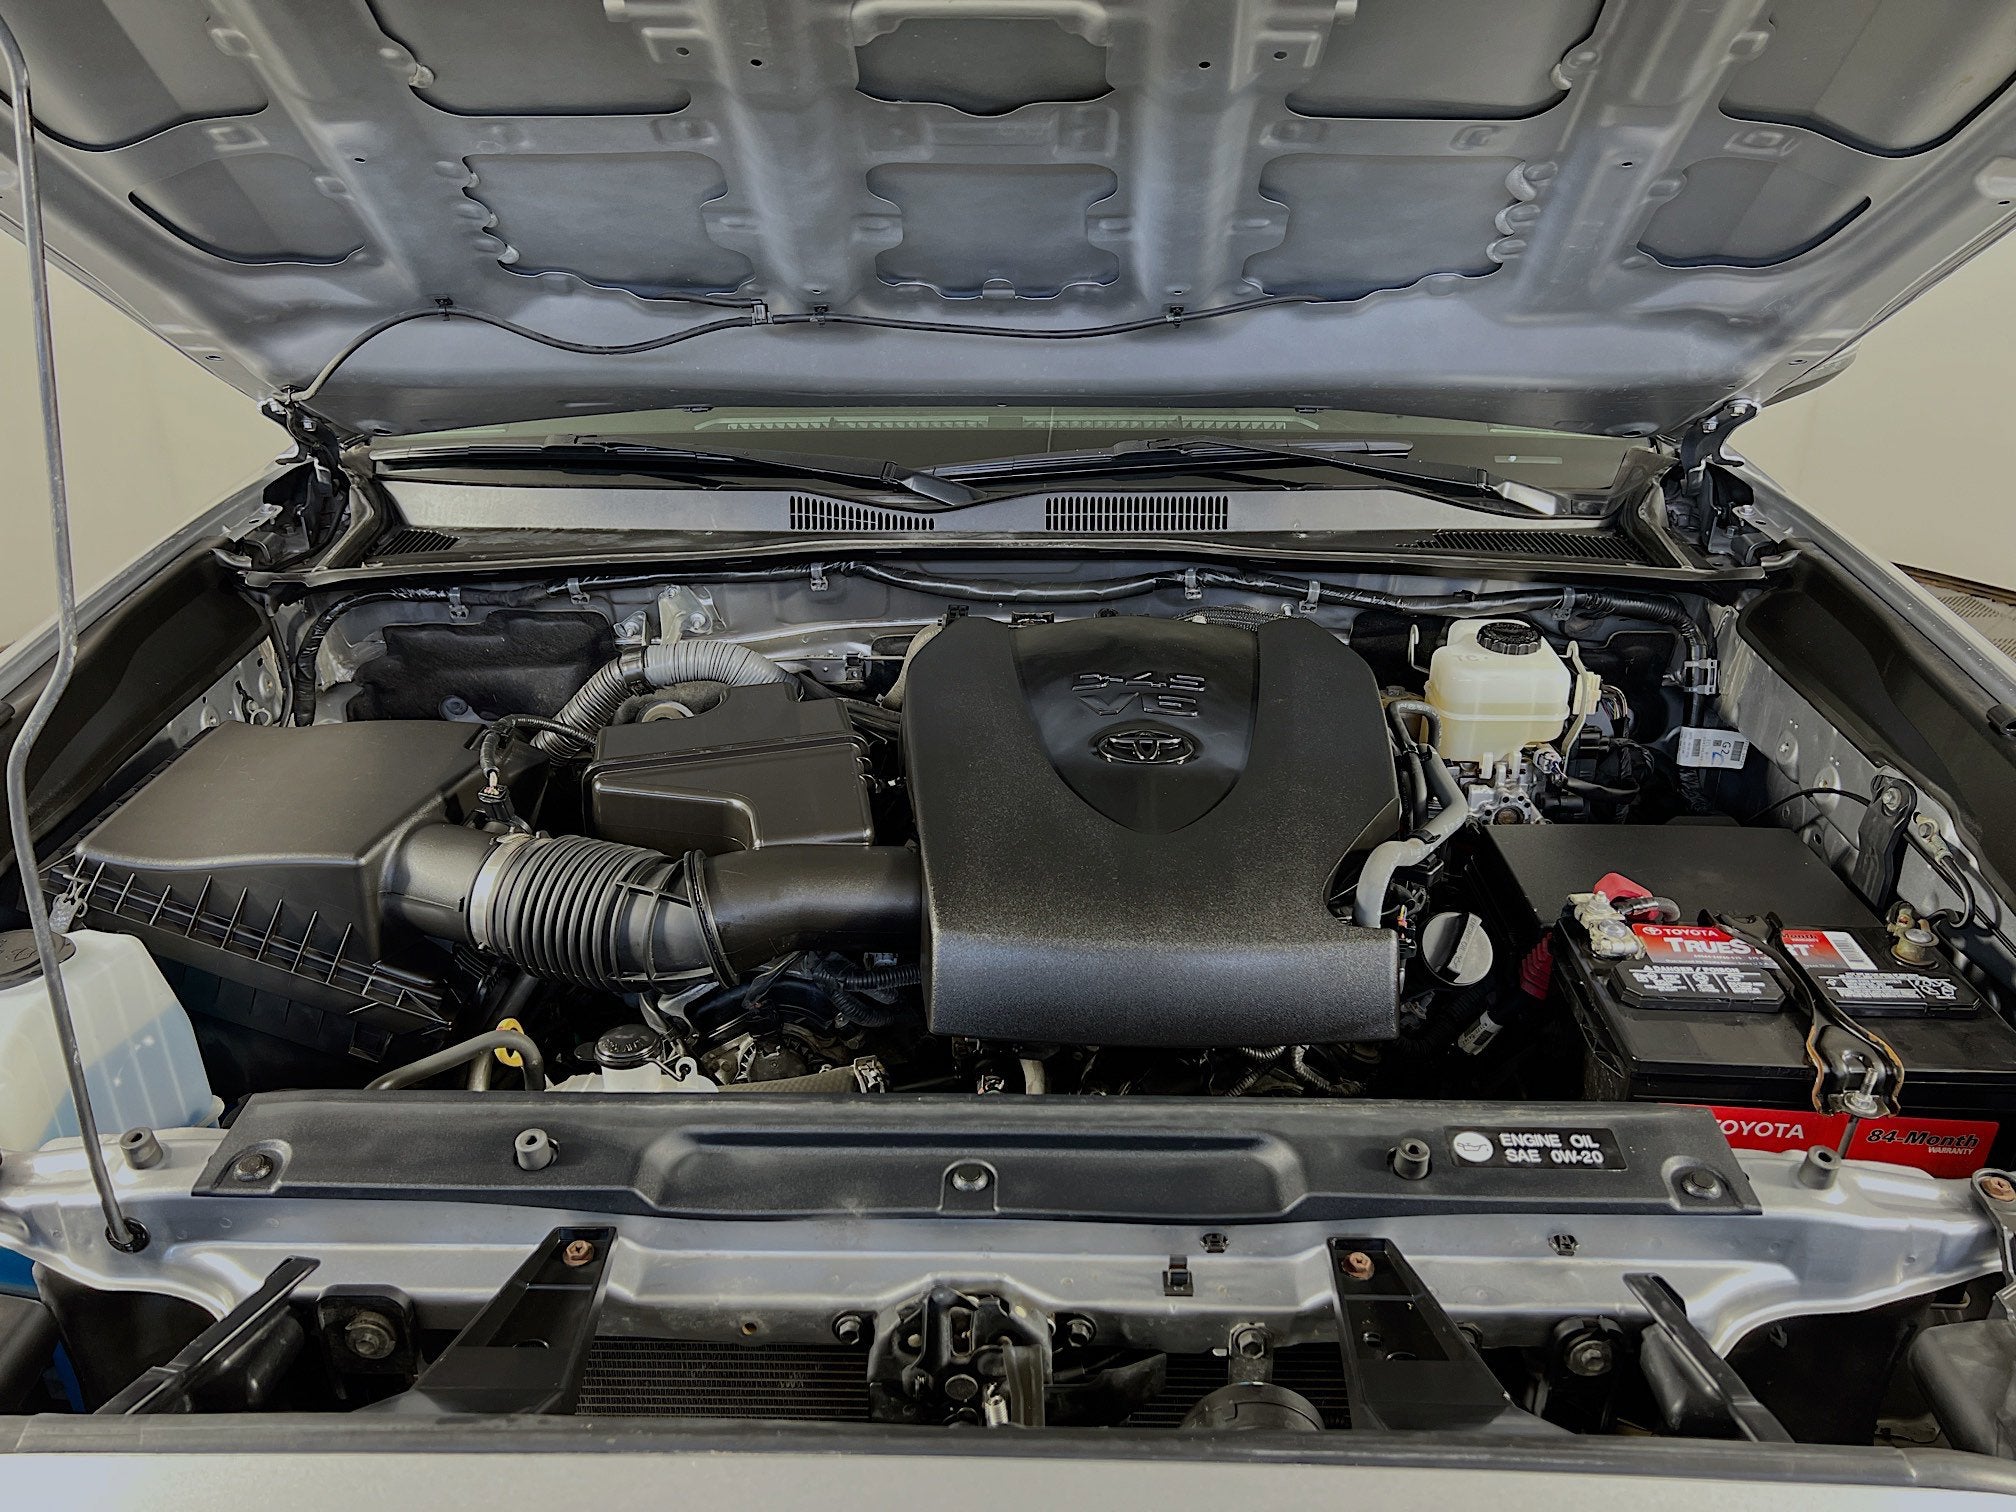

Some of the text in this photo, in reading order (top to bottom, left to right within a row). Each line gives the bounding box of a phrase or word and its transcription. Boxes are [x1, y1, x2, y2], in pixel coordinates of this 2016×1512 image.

[1076, 691, 1199, 717] V6
[1662, 928, 1719, 937] TOYOTA
[1499, 1133, 1601, 1149] ENGINE OIL
[1866, 1128, 1980, 1148] 84-Month
[1505, 1149, 1605, 1165] SAE 0W-20
[1928, 1146, 1975, 1155] WARRANTY
